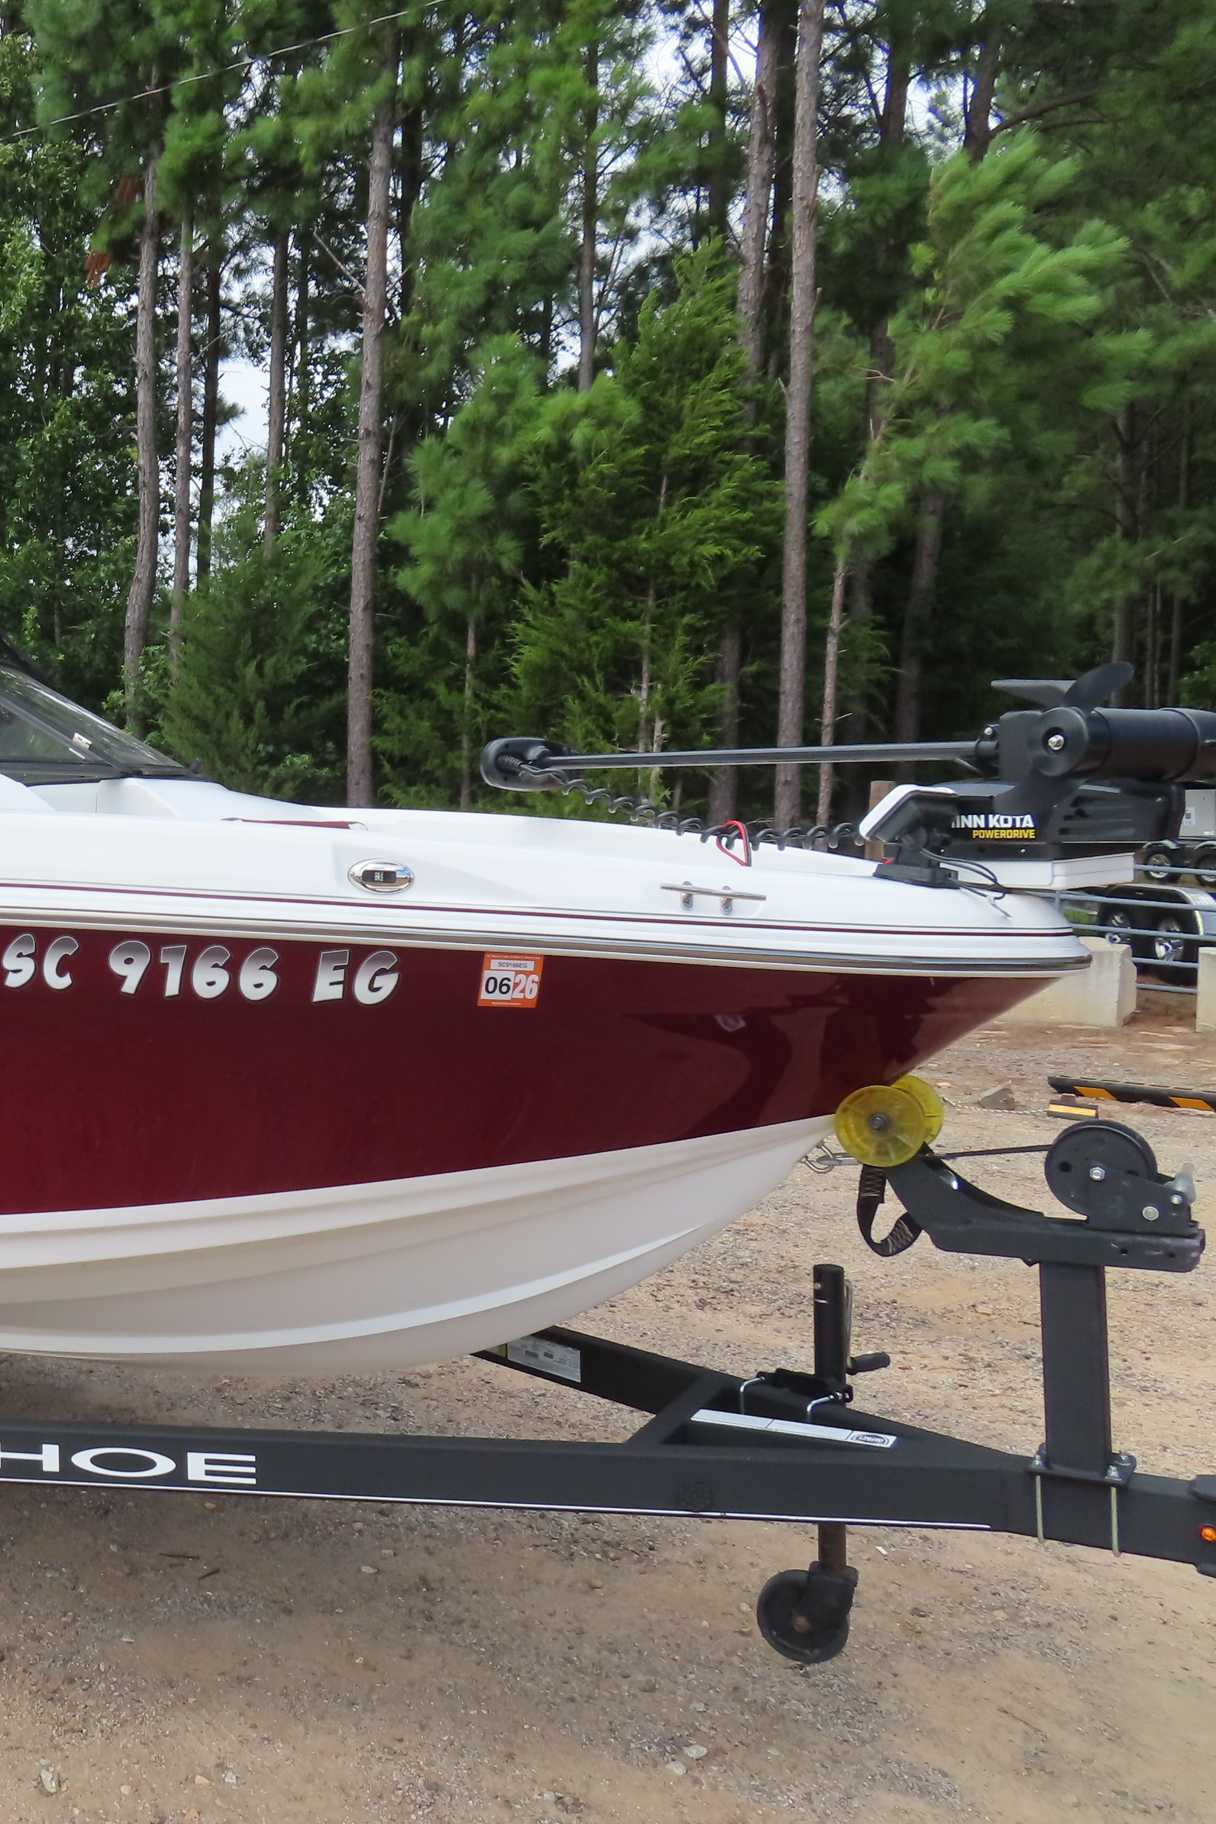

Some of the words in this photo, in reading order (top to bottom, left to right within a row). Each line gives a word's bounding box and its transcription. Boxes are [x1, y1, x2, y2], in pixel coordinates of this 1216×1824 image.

[988, 814, 1034, 829] KOTA
[972, 829, 1036, 839] POWERDRIVE
[1, 933, 79, 990] SC
[109, 940, 279, 1001] 9166
[312, 949, 399, 1005] EG
[484, 976, 512, 995] 06
[512, 973, 540, 1000] 26
